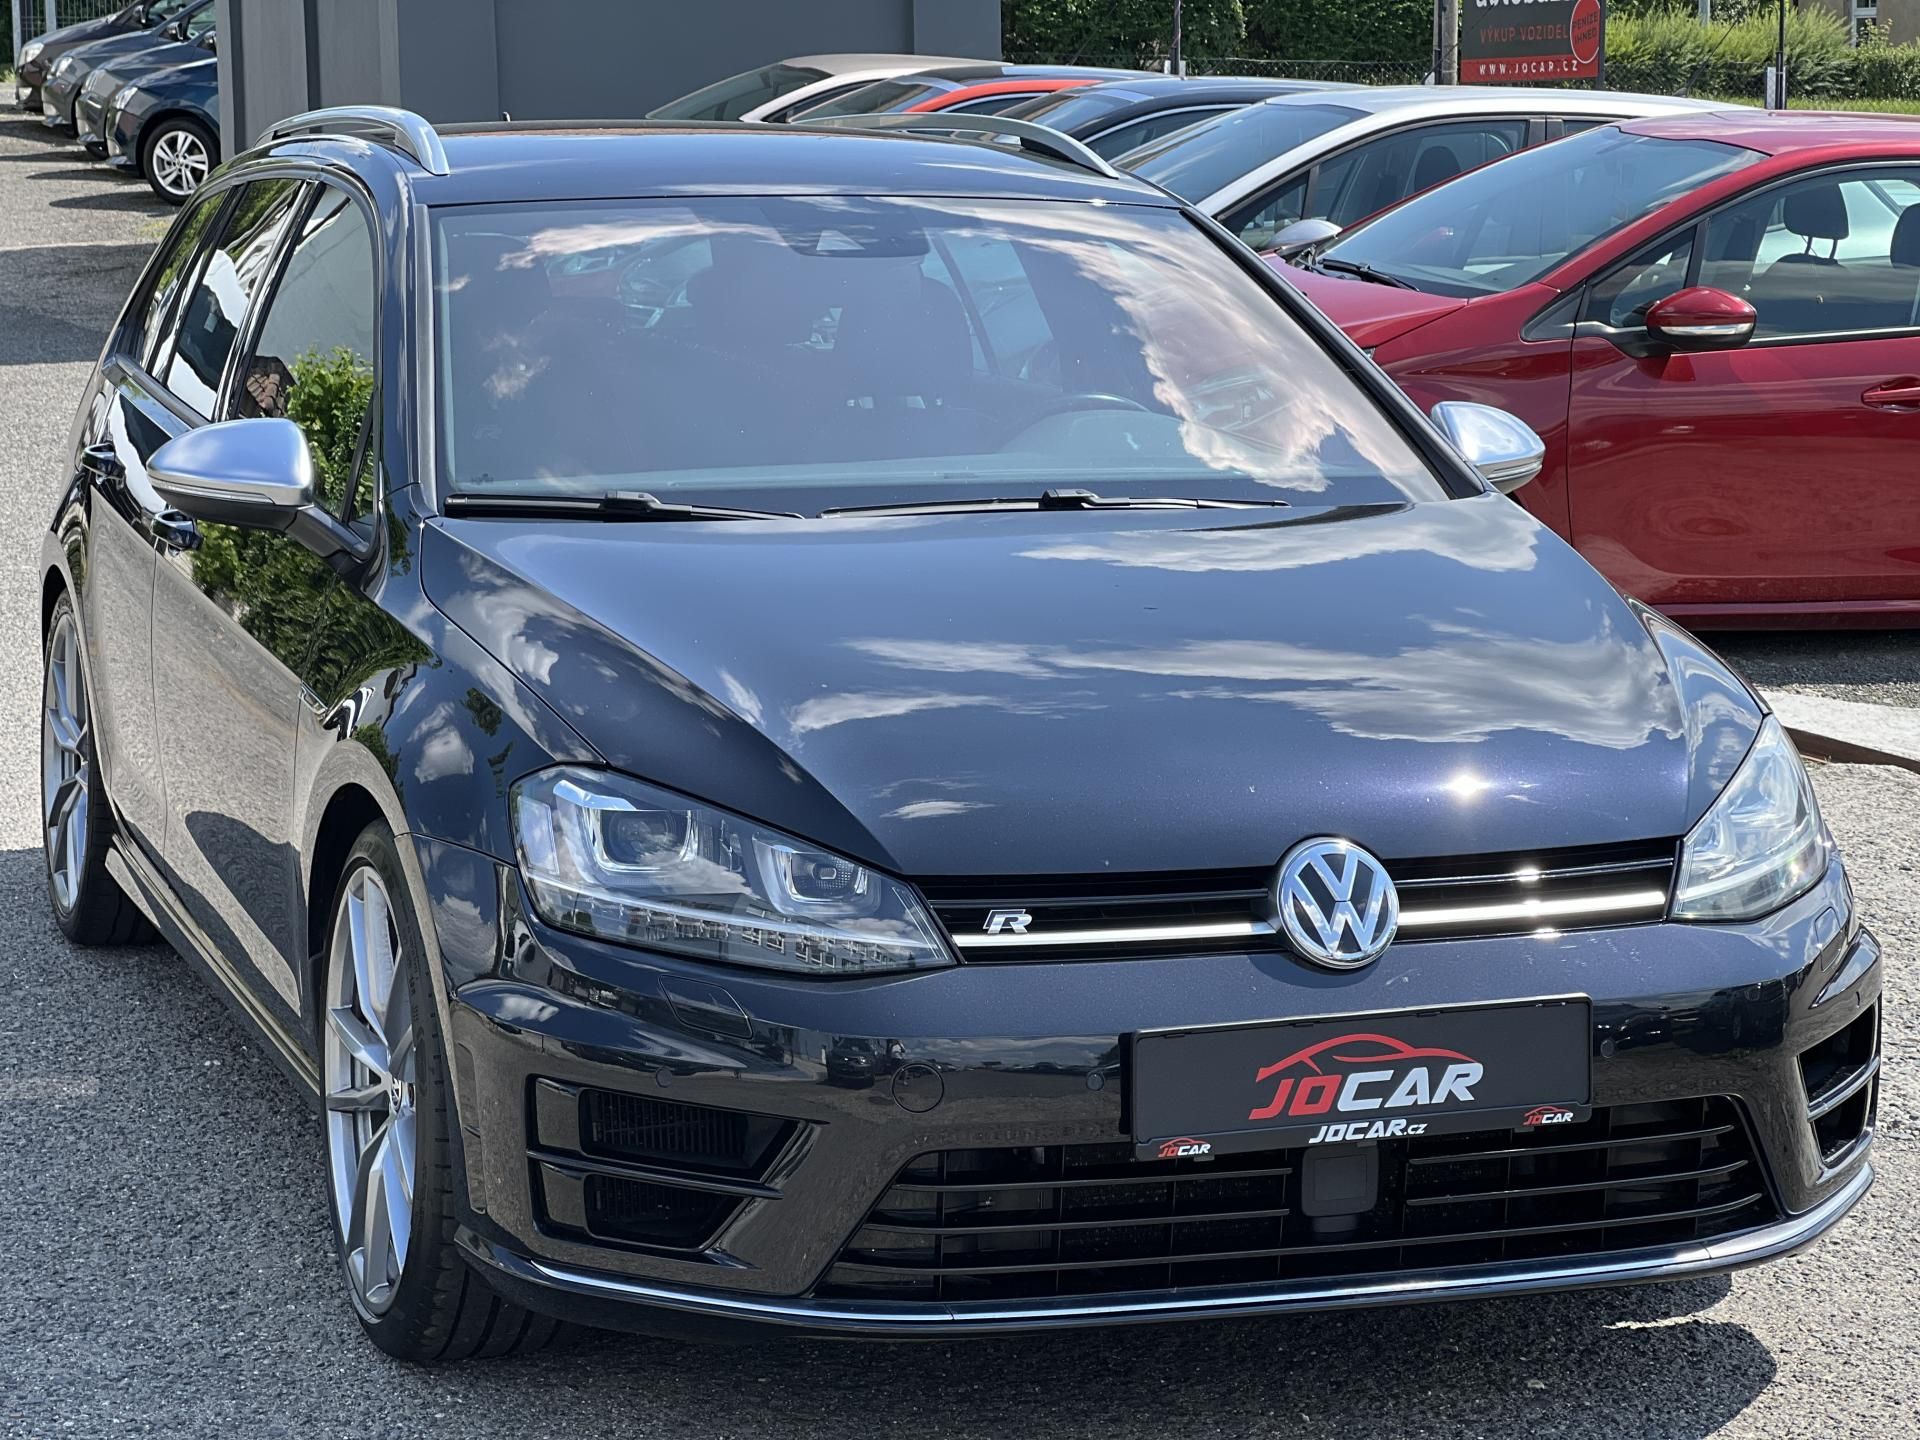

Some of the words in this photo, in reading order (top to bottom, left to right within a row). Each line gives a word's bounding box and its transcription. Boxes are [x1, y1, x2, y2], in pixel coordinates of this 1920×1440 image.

[1519, 24, 1568, 41] VOZIDEL
[1479, 60, 1578, 75] WWW.JOCAR.CZ
[983, 909, 1032, 934] R
[1248, 1062, 1484, 1120] JOCAR
[1523, 1112, 1574, 1126] JOCAR
[1158, 1143, 1212, 1158] JOCAR
